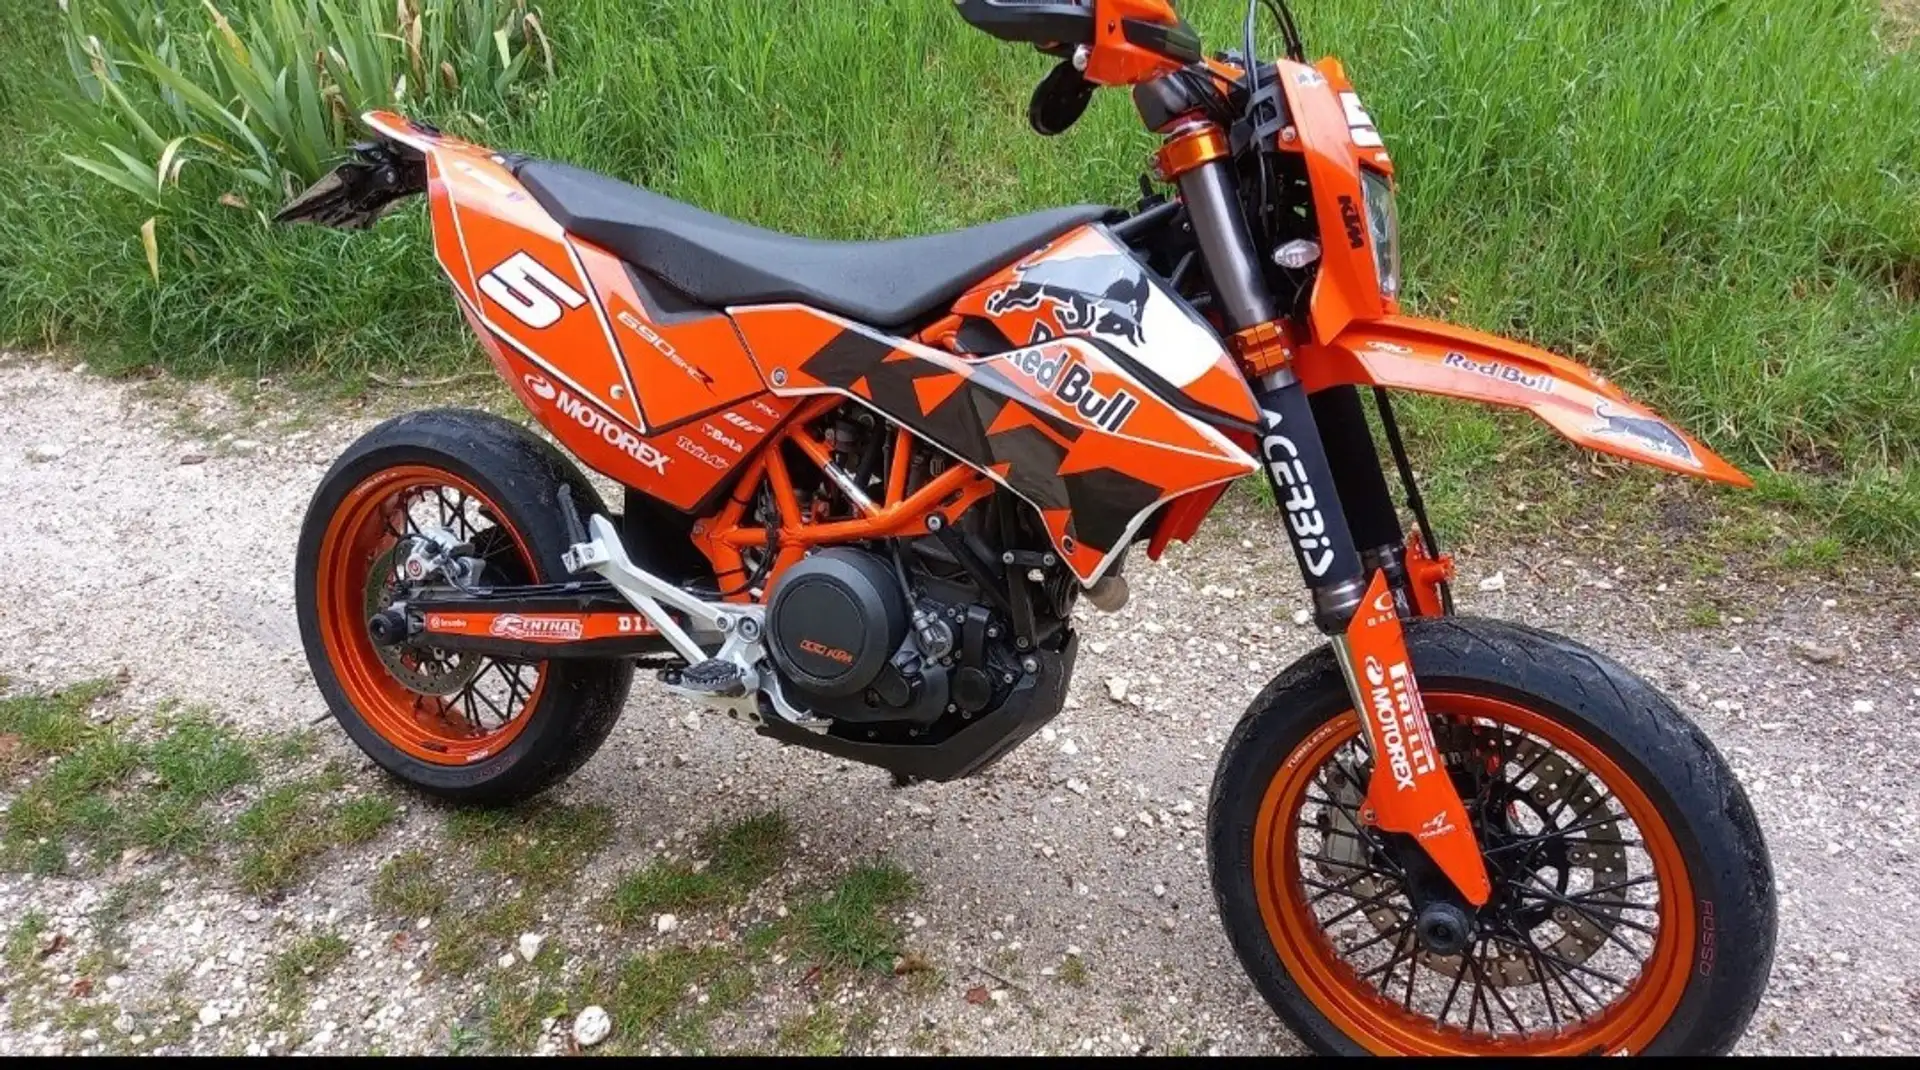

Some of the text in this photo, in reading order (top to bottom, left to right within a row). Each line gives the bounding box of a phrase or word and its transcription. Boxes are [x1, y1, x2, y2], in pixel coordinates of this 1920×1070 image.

[1337, 195, 1364, 249] KTM
[477, 249, 589, 329] 5
[1055, 362, 1140, 435] Bull
[1444, 352, 1554, 392] Red Bull
[555, 395, 673, 475] MOTOREX
[1372, 684, 1416, 791] MOTOREX
[1389, 661, 1437, 775] PIRELLI
[1699, 901, 1716, 976] ROSSO
